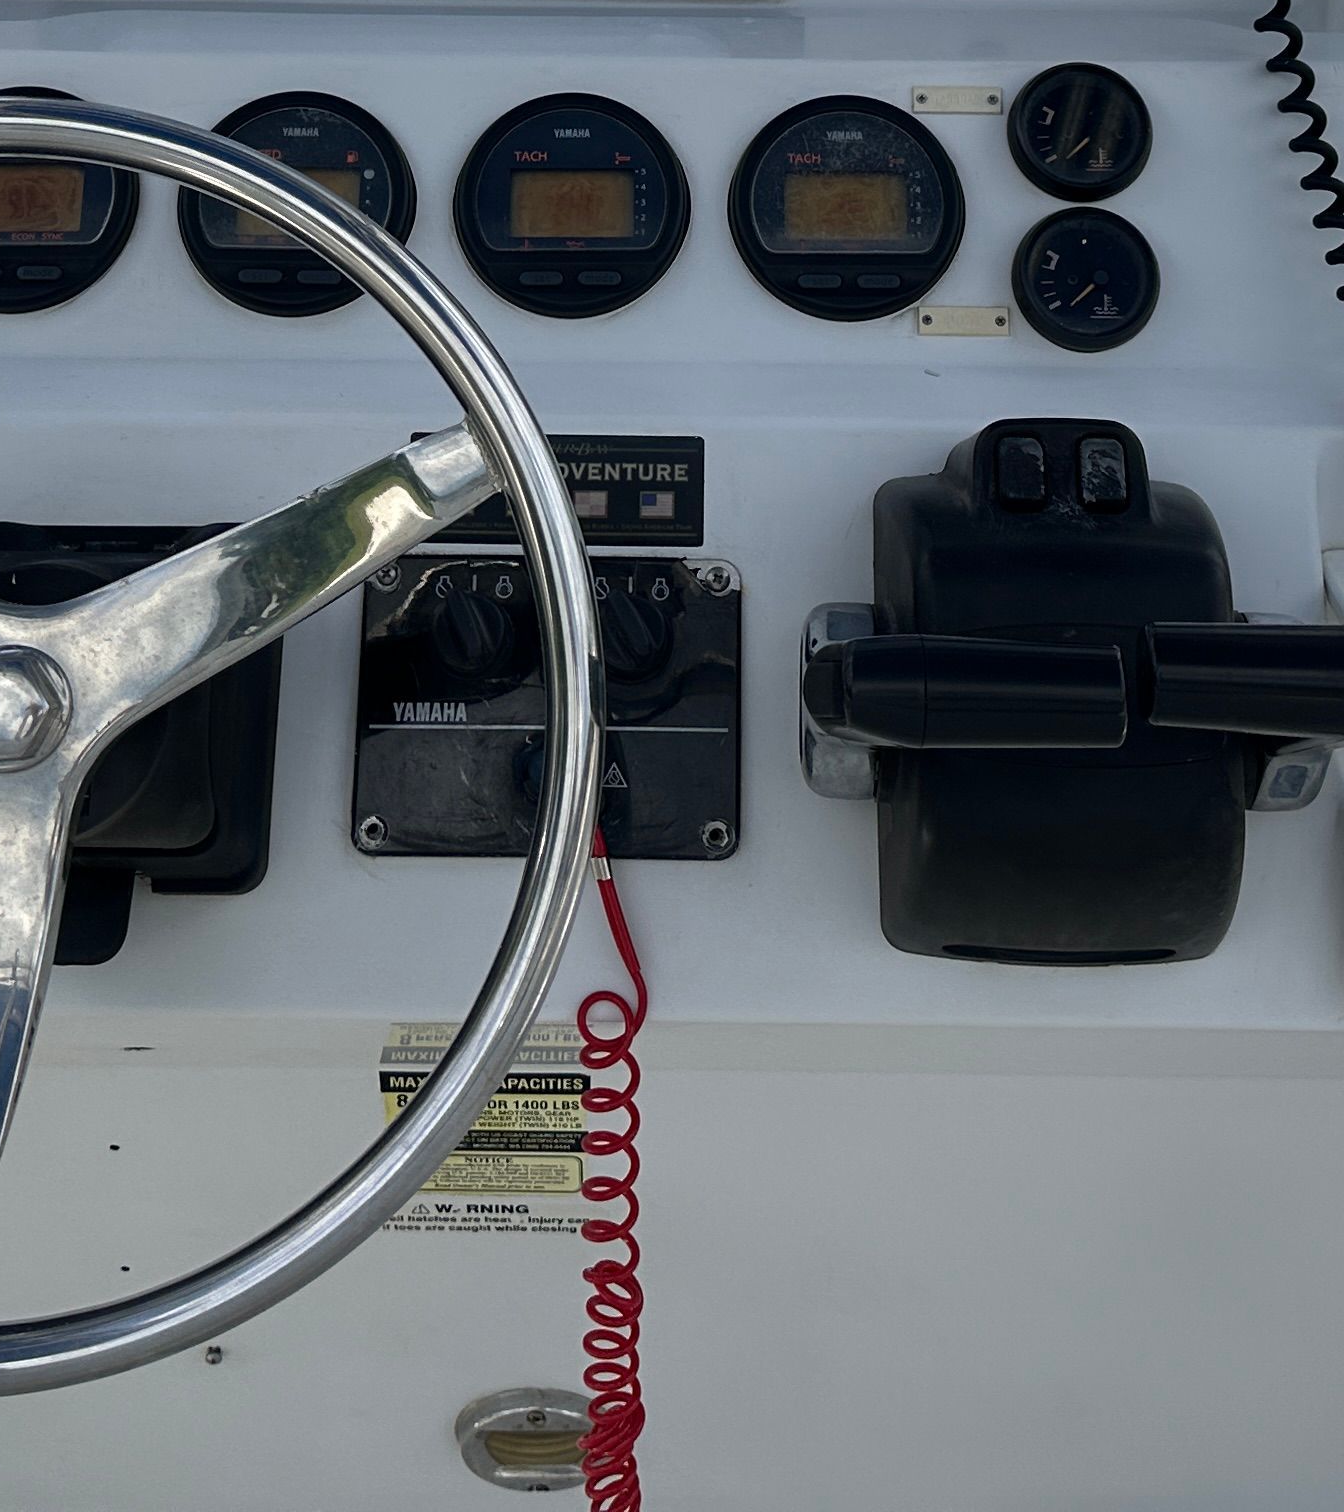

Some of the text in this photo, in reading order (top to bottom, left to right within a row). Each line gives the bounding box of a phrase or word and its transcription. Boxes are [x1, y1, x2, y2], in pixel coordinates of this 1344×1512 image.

[283, 127, 320, 137] YAMAHA
[554, 128, 591, 138] YAMAHA
[826, 131, 863, 140] YAMAHA
[514, 151, 548, 162] TACH
[786, 153, 821, 164] TACH
[11, 233, 36, 241] ECON
[41, 233, 64, 241] SYNC
[559, 462, 689, 482] DVENTURE
[393, 701, 467, 723] YAMAHA
[397, 1093, 580, 1110] 8 OR 1400 LBS
[448, 1224, 492, 1233] caught
[531, 1226, 577, 1234] closing
